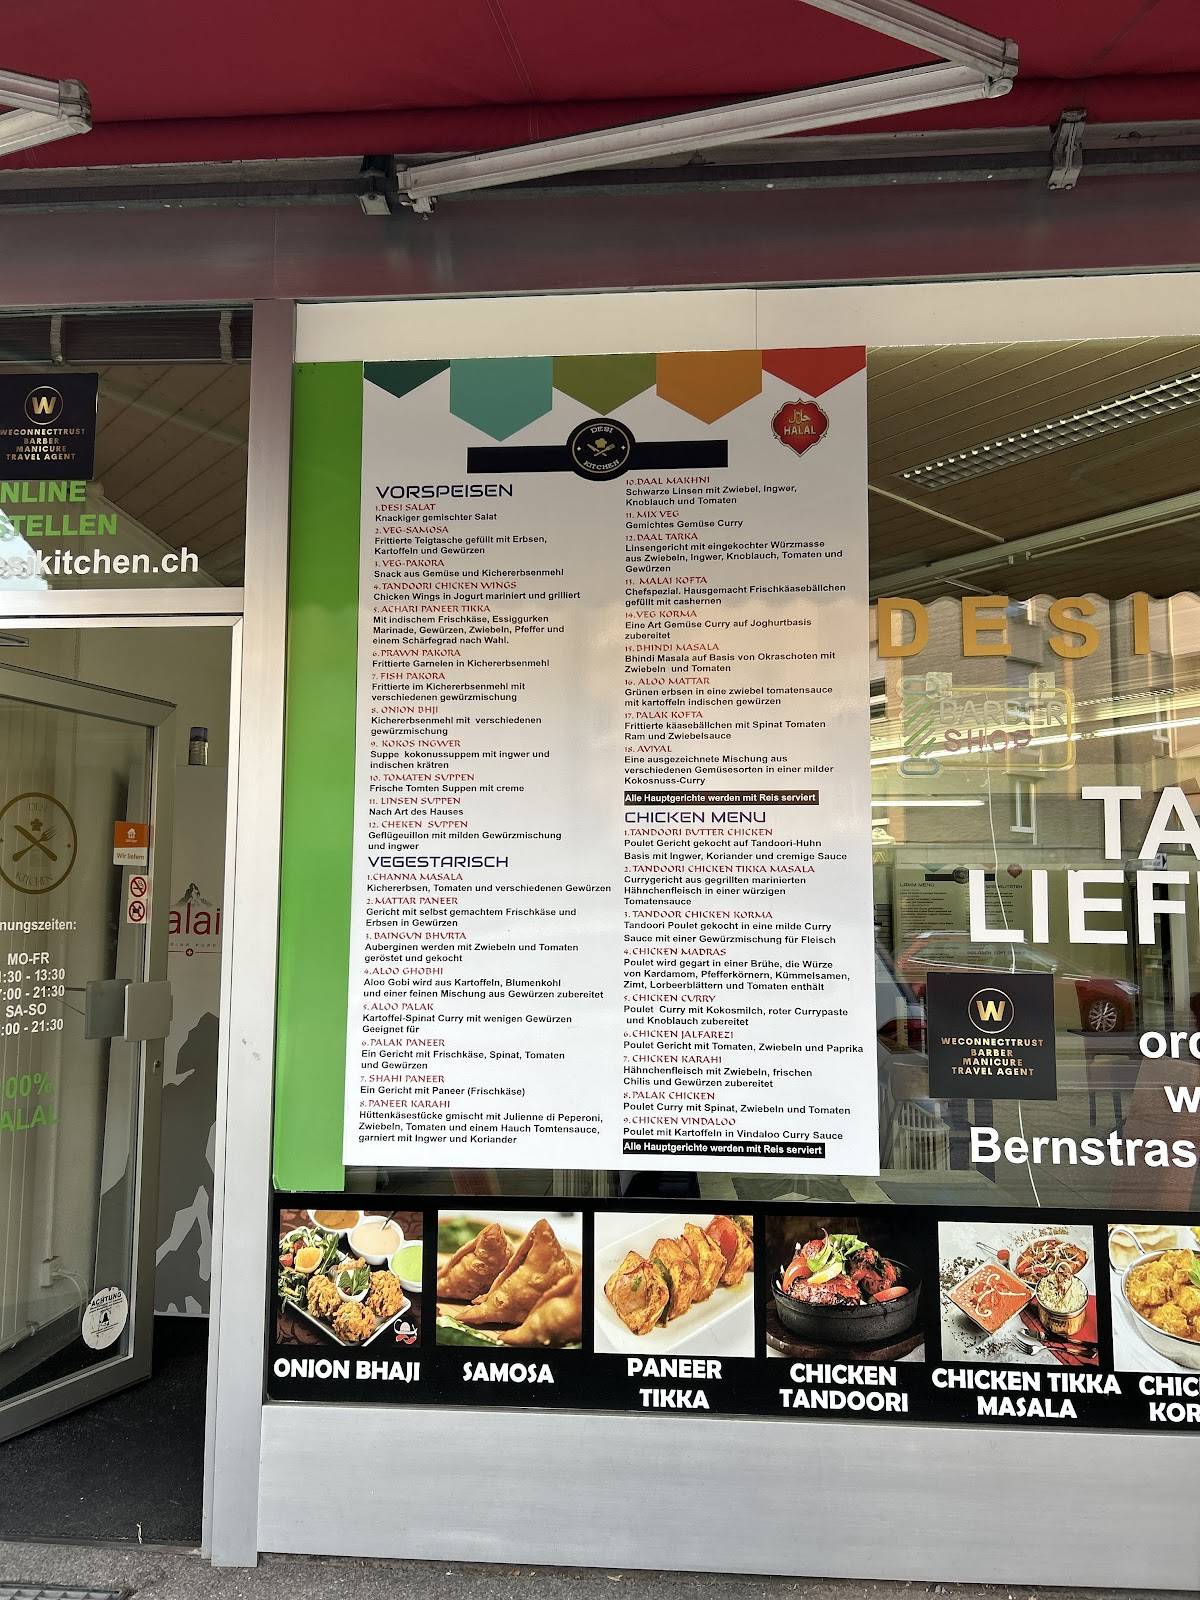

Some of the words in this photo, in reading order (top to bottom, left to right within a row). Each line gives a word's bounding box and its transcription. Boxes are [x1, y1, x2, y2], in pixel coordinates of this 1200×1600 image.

[32, 396, 57, 415] W
[0, 428, 86, 437] WECONNECTTRUST
[590, 425, 614, 434] DESI
[783, 425, 817, 436] HALAL
[6, 453, 41, 461] TRAVEL
[44, 453, 76, 461] AGENT
[583, 459, 620, 470] KITCHEN
[375, 483, 513, 499] VORSPEISEN
[625, 497, 675, 506] Knoblauch
[677, 497, 695, 505] und
[697, 496, 737, 505] Tomaten
[405, 503, 436, 512] SALAT
[375, 513, 421, 523] Knackiger
[421, 513, 473, 523] gemischter
[474, 512, 497, 521] Salat
[383, 525, 449, 534] VEG-SAMOSA
[374, 536, 413, 545] Frittierte
[414, 536, 463, 546] Teigtasche
[464, 535, 494, 546] gefüllt
[495, 535, 511, 543] mit
[512, 535, 547, 544] Erbsen,
[373, 592, 410, 601] Chicken
[411, 592, 440, 602] Wings
[442, 592, 451, 600] in
[485, 591, 526, 600] mariniert
[528, 591, 546, 600] und
[548, 591, 581, 601] grilliert
[877, 592, 1150, 659] DESI
[372, 636, 400, 645] einem
[459, 636, 482, 644] nach
[483, 636, 509, 644] Wahl.
[380, 672, 403, 680] FISH
[406, 672, 446, 680] PAKORA
[636, 711, 668, 719] PALAK
[671, 710, 703, 719] KOFTA
[938, 699, 1065, 727] BARBER
[943, 728, 1034, 754] SHOP
[624, 776, 706, 786] Kokosnuss-Curry
[369, 784, 404, 792] Frische
[441, 784, 477, 794] Suppen
[479, 784, 494, 792] mit
[624, 793, 642, 802] Alle
[643, 793, 706, 804] Hauptgerichte
[707, 793, 741, 802] werden
[742, 793, 757, 802] mit
[759, 793, 779, 802] Reis
[780, 793, 816, 802] serviert
[368, 807, 392, 816] Nach
[393, 807, 409, 816] Art
[410, 807, 427, 816] des
[429, 807, 464, 816] Hauses
[624, 811, 705, 823] CHICKEN
[711, 811, 766, 823] MENU
[685, 828, 724, 836] BUTTER
[727, 828, 773, 836] CHICKEN
[367, 855, 509, 868] VEGESTARISCH
[366, 883, 431, 892] Kichererbsen,
[433, 883, 473, 892] Tomaten
[474, 883, 493, 892] und
[494, 884, 563, 892] verschiedenen
[564, 884, 611, 892] Gewürzen
[968, 869, 1200, 945] LIEF
[680, 947, 727, 956] MADRAS
[7, 952, 50, 965] MO-FR
[34, 968, 66, 981] 13:30
[643, 969, 698, 979] Kardamom,
[33, 984, 65, 999] 21:30
[6, 1003, 47, 1018] SA-SO
[975, 1000, 1006, 1021] W
[31, 1018, 64, 1033] 21:30
[941, 1037, 1044, 1047] WECONNECTTRUST
[970, 1049, 1014, 1057] BARBER
[962, 1058, 1023, 1067] MANICURE
[951, 1066, 993, 1076] TRAVEL
[996, 1067, 1035, 1076] AGENT
[623, 1077, 651, 1086] Chilis
[653, 1077, 672, 1086] und
[674, 1077, 723, 1087] Gewürzen
[724, 1078, 774, 1088] zubereitet
[360, 1085, 375, 1094] Ein
[377, 1085, 412, 1094] Gericht
[414, 1086, 430, 1095] mit
[432, 1086, 465, 1095] Paneer
[467, 1086, 525, 1097] (Frischkäse)
[623, 1102, 654, 1111] Poulet
[656, 1102, 684, 1113] Curry
[686, 1103, 702, 1112] mit
[703, 1103, 738, 1114] Spinat,
[740, 1104, 784, 1113] Zwiebeln
[787, 1105, 806, 1114] und
[808, 1105, 851, 1115] Tomaten
[358, 1134, 395, 1143] garniert
[397, 1133, 412, 1142] mit
[415, 1134, 447, 1144] Ingwer
[449, 1134, 467, 1143] und
[470, 1134, 517, 1144] Koriander
[623, 1142, 642, 1151] Alle
[643, 1142, 708, 1154] Hauptgerichte
[709, 1143, 744, 1153] werden
[746, 1144, 762, 1153] mit
[763, 1144, 784, 1154] Reis
[786, 1145, 822, 1155] serviert
[91, 1291, 122, 1307] ACHTUNG
[273, 1358, 350, 1379] ONION
[356, 1360, 421, 1382] BHAJI
[462, 1362, 555, 1384] SAMOSA
[627, 1357, 722, 1379] PANEER
[790, 1363, 897, 1386] CHICKEN
[932, 1368, 1041, 1392] CHICKEN
[1046, 1372, 1122, 1395] TIKKA
[1139, 1375, 1200, 1397] CHIC
[639, 1388, 710, 1410] TIKKA
[778, 1389, 909, 1413] TANDOORI
[977, 1396, 1078, 1419] MASALA
